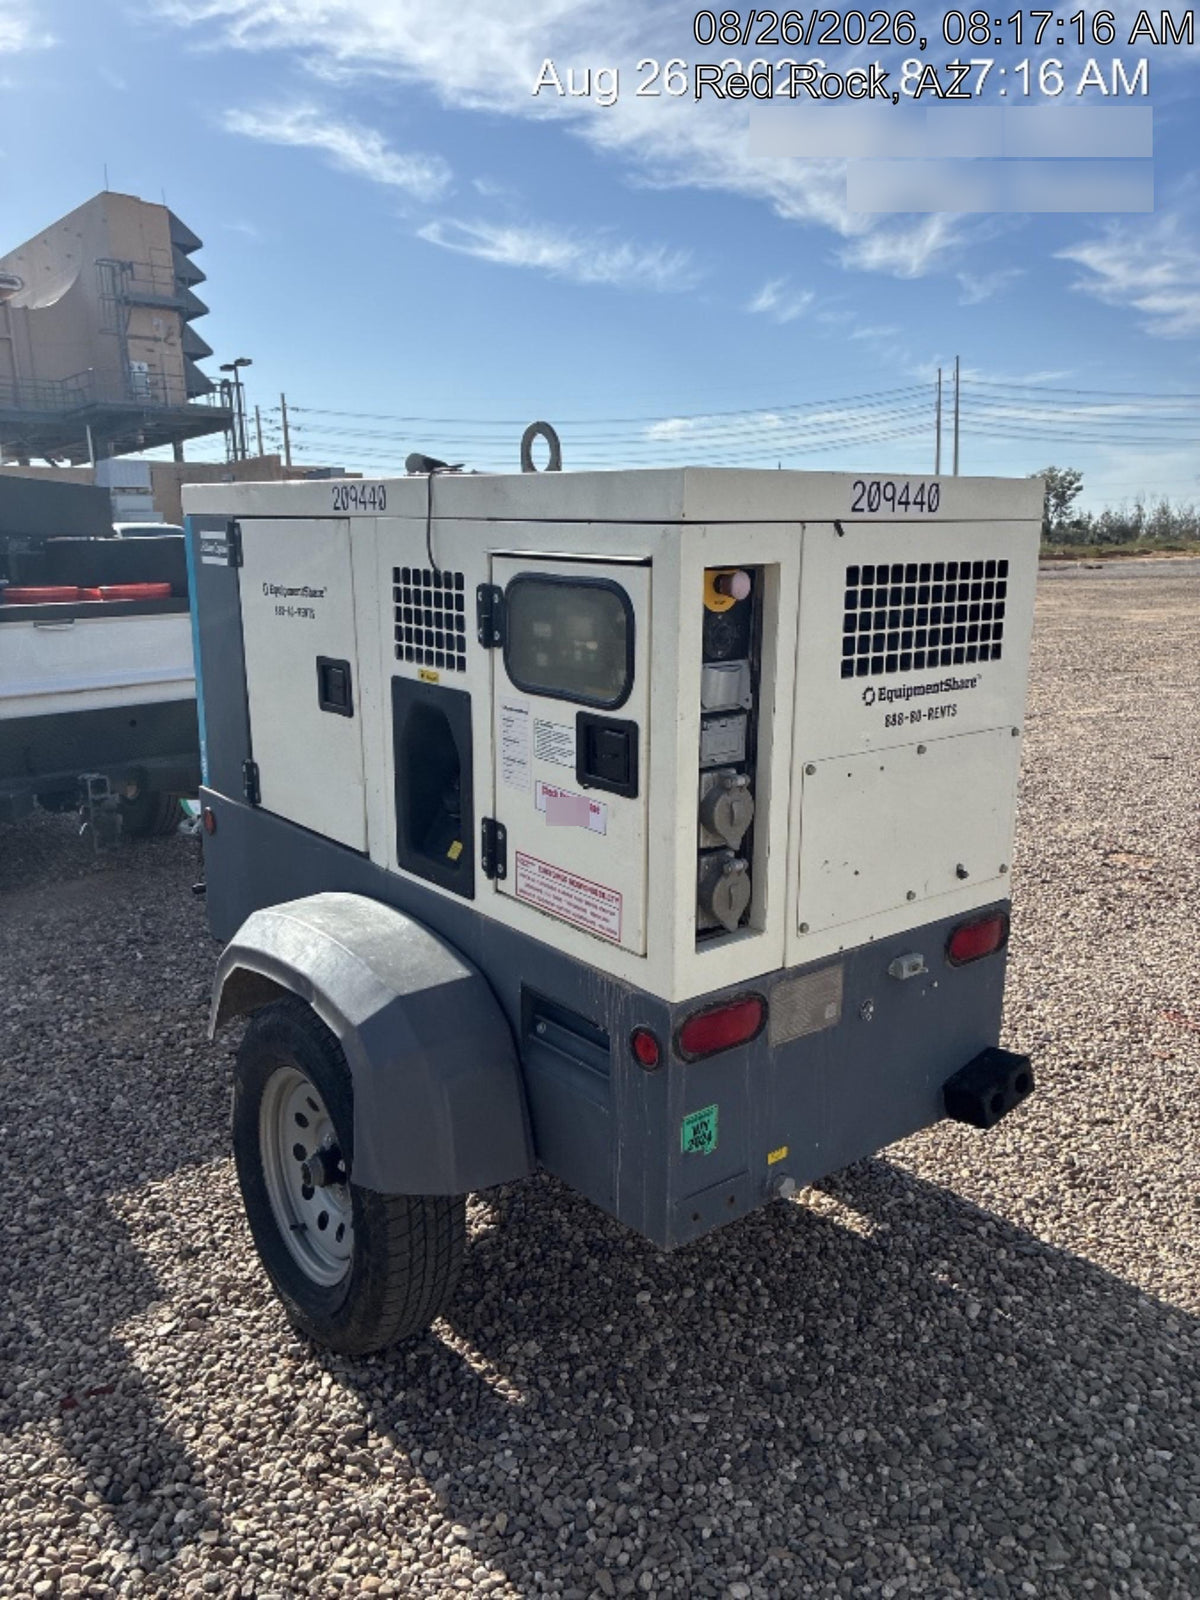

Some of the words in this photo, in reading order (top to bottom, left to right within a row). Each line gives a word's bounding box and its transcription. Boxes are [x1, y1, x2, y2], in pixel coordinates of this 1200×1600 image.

[331, 484, 387, 511] 209440
[851, 480, 940, 513] 209440
[877, 677, 978, 703] EquipmentShare
